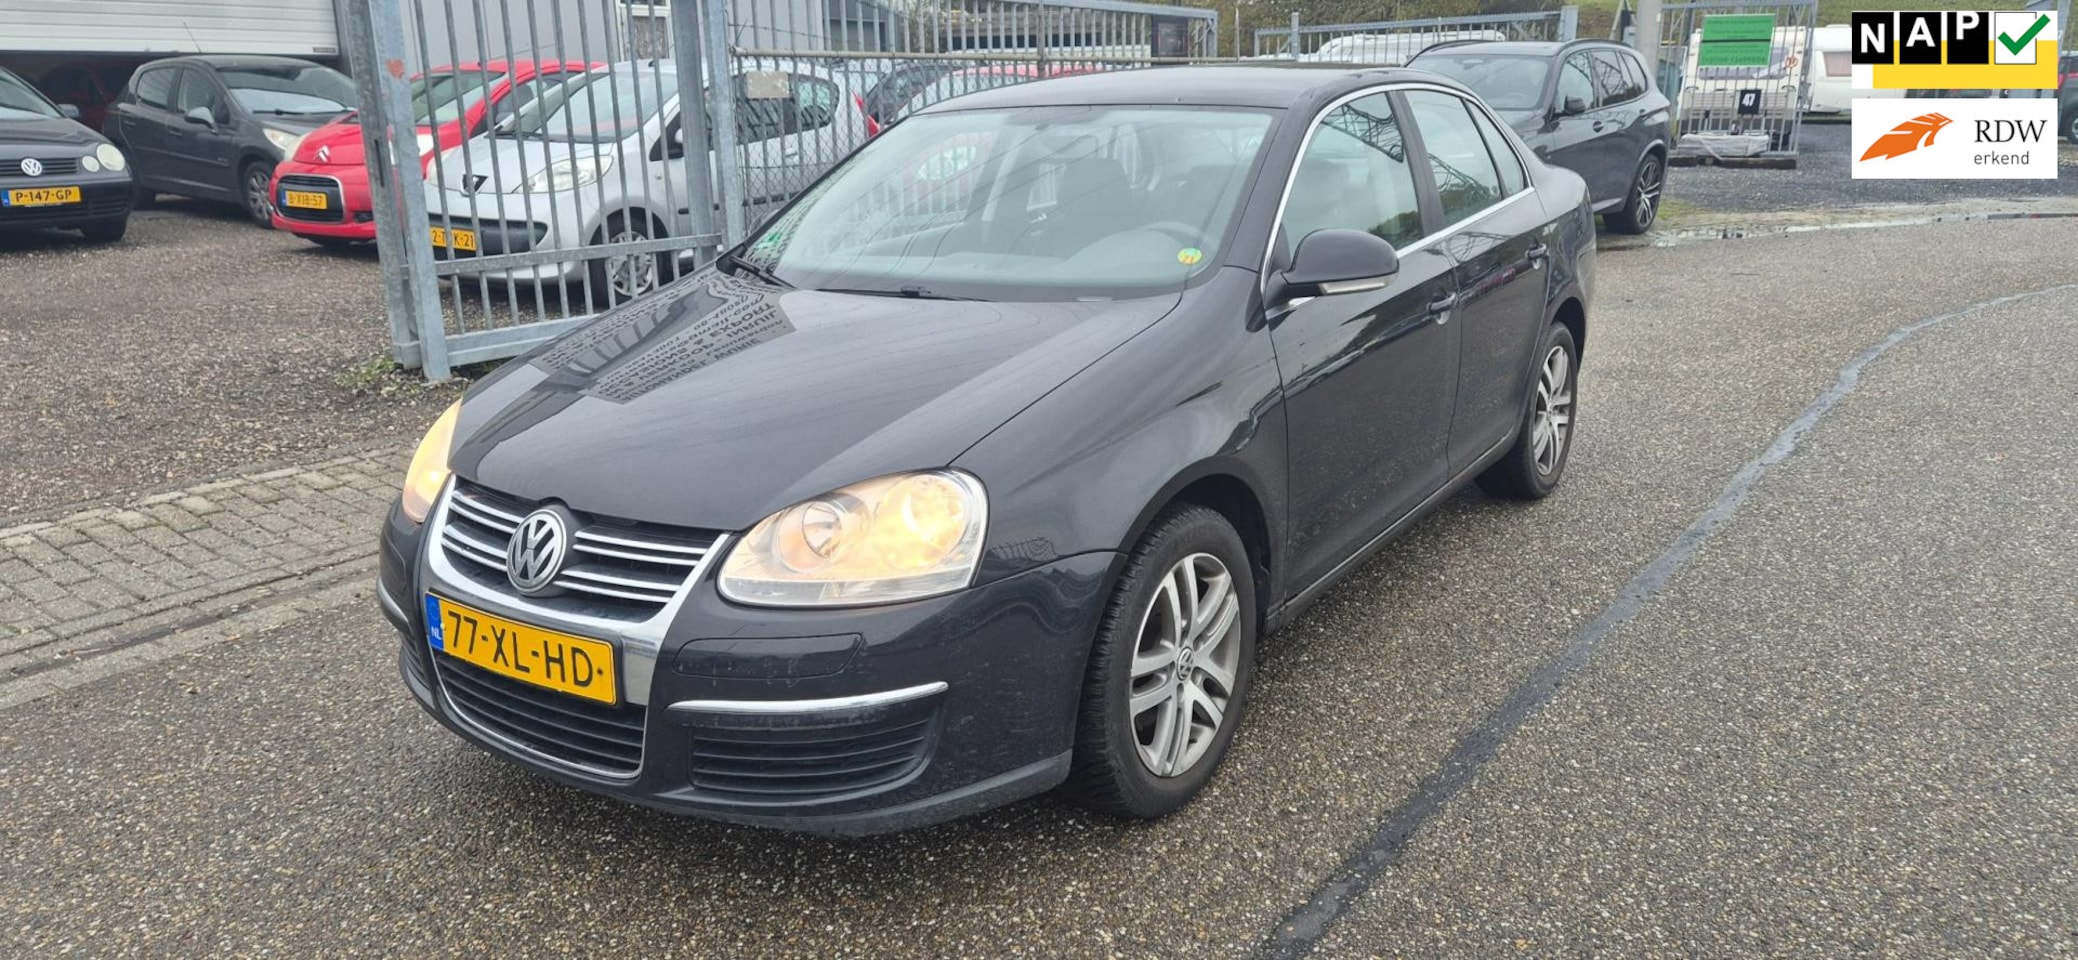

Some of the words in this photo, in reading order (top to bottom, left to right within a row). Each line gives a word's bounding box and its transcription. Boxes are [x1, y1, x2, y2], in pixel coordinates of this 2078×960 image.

[1742, 93, 1756, 107] 47
[15, 189, 72, 203] P-147-GP
[432, 229, 474, 249] 2-TK-21
[431, 626, 442, 640] NL
[448, 610, 593, 688] 77-XL-HD
